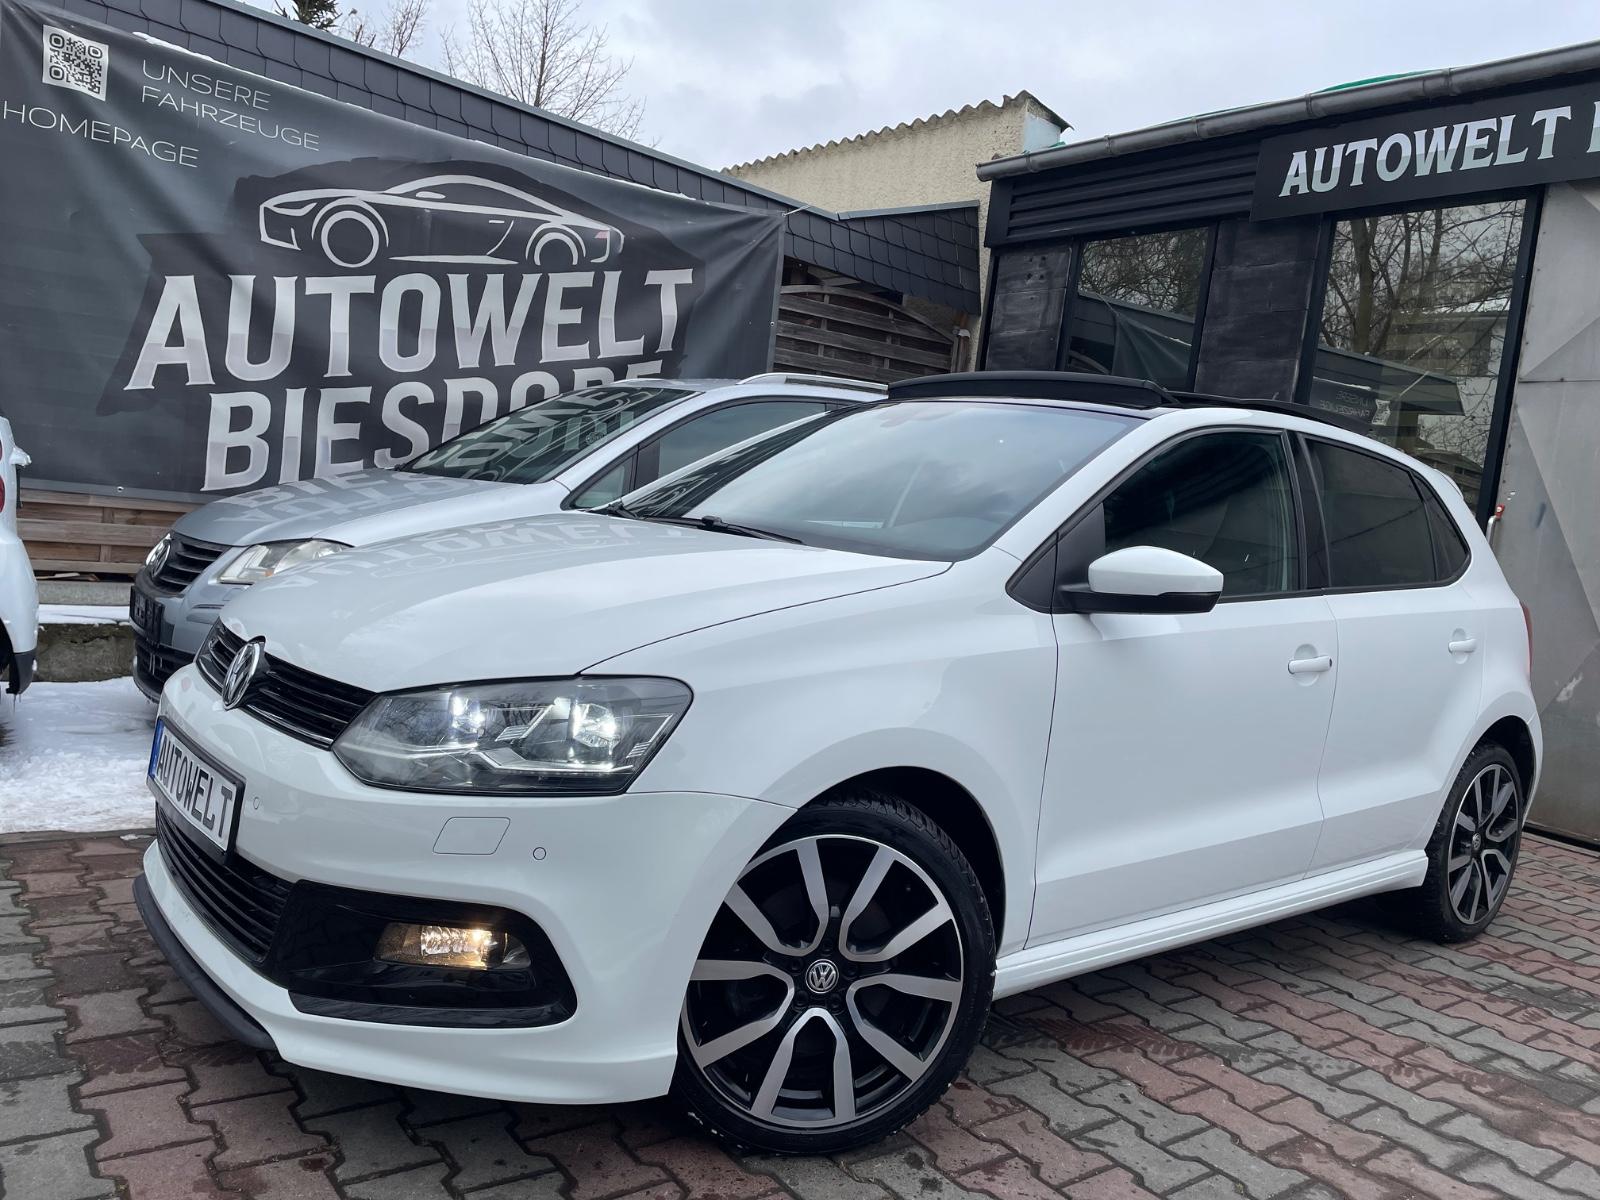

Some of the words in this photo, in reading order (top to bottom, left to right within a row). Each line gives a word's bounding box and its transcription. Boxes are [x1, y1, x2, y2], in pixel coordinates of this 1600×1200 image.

[141, 59, 272, 112] UNSERE
[141, 85, 321, 152] FAHRZEUGE
[3, 102, 200, 169] HOMEPAGE
[1278, 105, 1572, 198] AUTOWELT
[123, 267, 694, 391] AUTOWELT
[200, 359, 663, 492] BIESD
[156, 734, 234, 839] AUTOWELT
